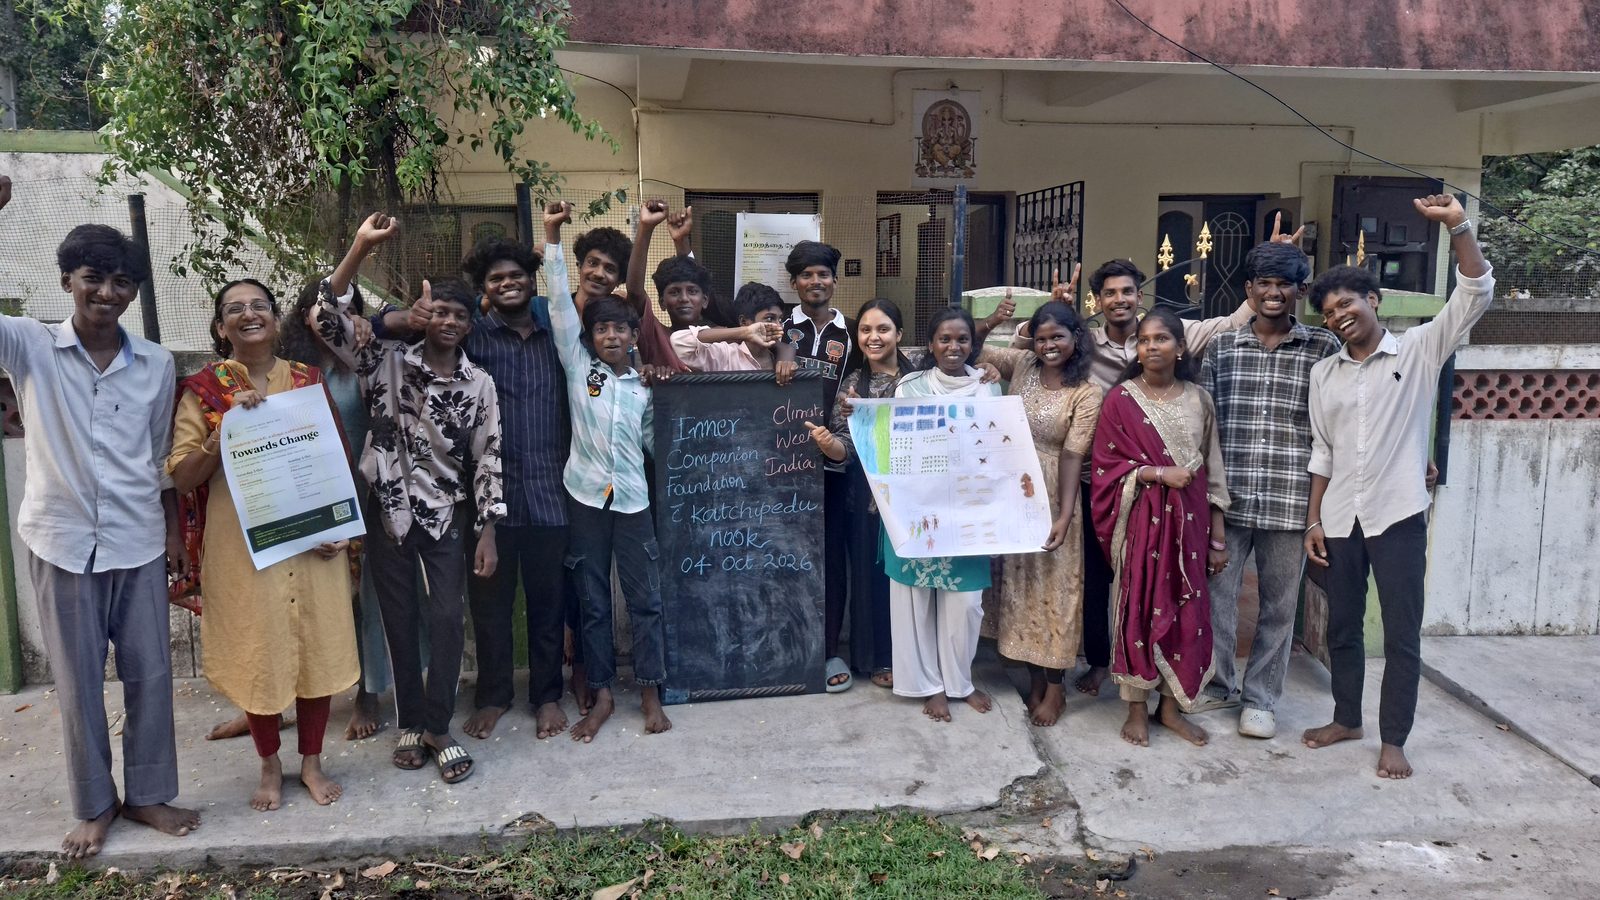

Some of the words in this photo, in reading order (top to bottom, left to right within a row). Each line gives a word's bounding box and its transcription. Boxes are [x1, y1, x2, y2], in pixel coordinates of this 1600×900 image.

[773, 399, 825, 425] Climate
[671, 416, 741, 442] Inner
[230, 438, 278, 460] Towards
[279, 430, 320, 447] Change
[666, 446, 760, 473] Companion
[765, 453, 816, 476] India
[666, 472, 747, 497] Foundation
[680, 553, 712, 576] 04
[721, 553, 754, 571] Oct
[763, 552, 813, 571] 2026
[438, 746, 468, 767] NIKE
